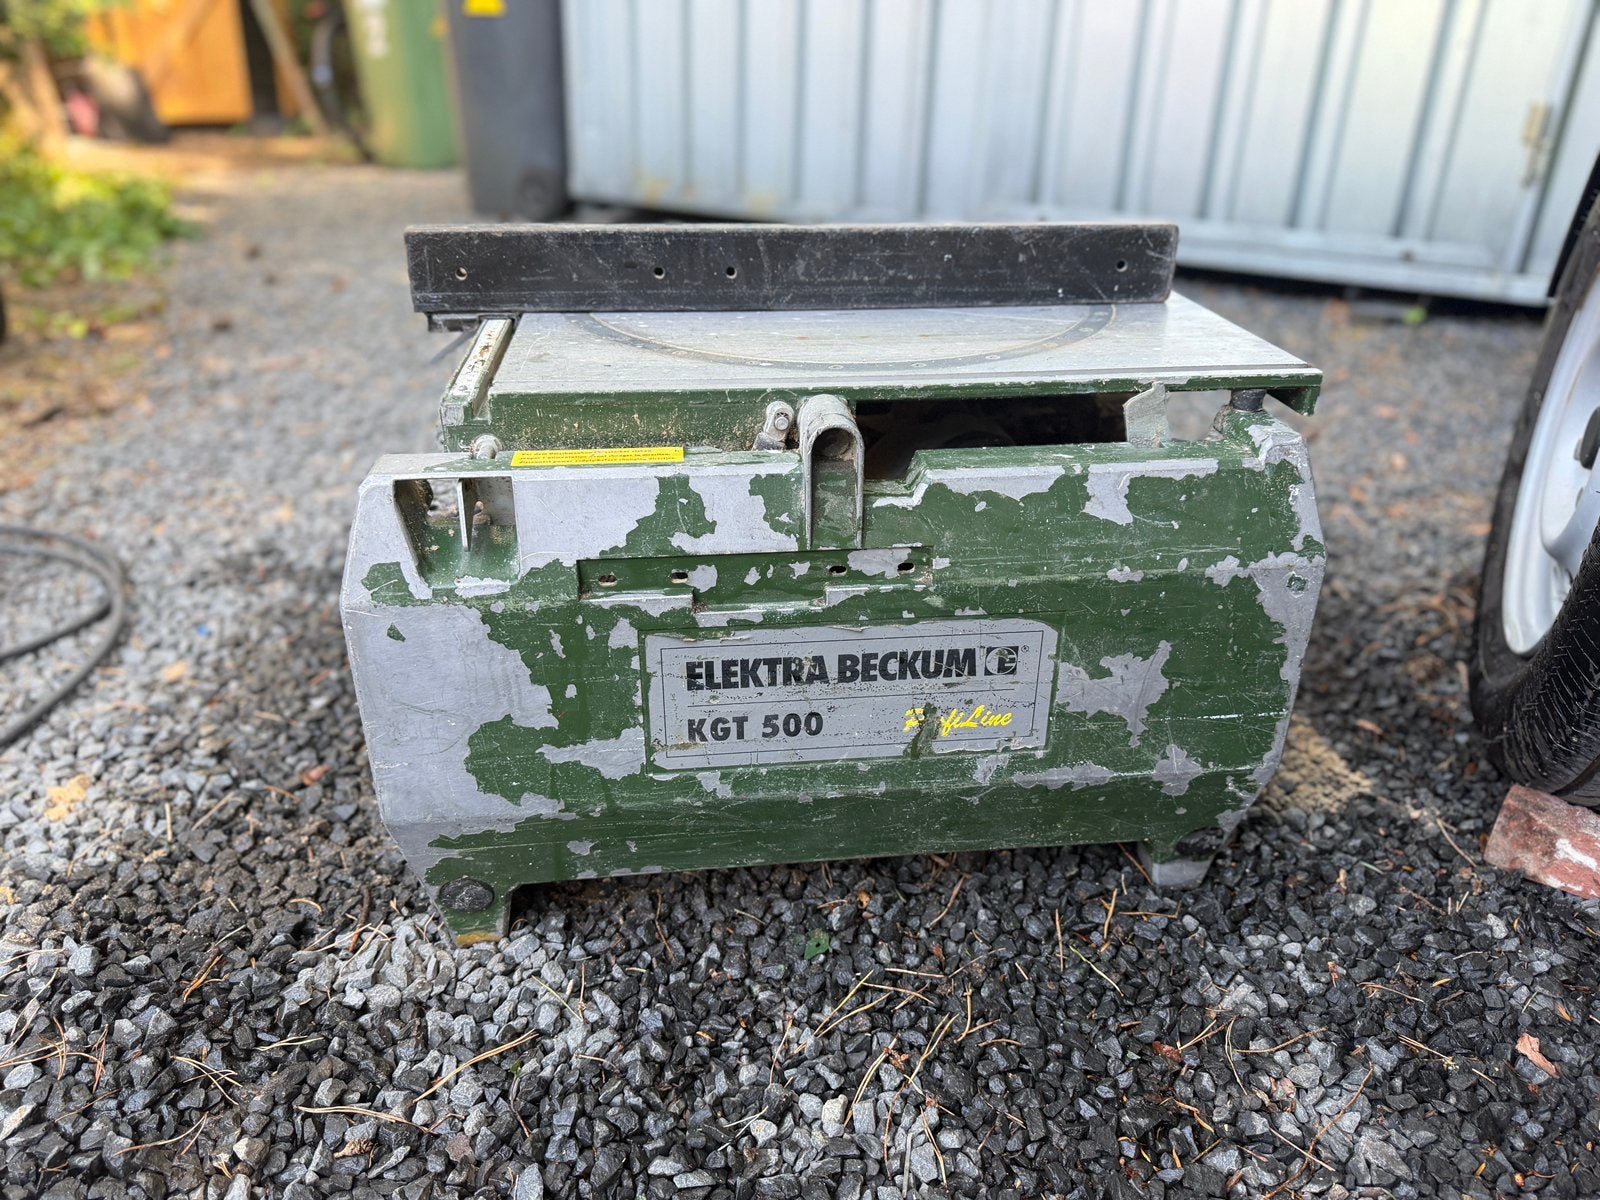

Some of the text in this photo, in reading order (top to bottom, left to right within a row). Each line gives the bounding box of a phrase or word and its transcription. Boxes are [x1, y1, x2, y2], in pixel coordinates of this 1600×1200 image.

[686, 655, 830, 691] ELEKTRA
[837, 647, 977, 684] BECKUM
[687, 711, 824, 743] KGT 500
[903, 704, 1013, 737] PfiLine
